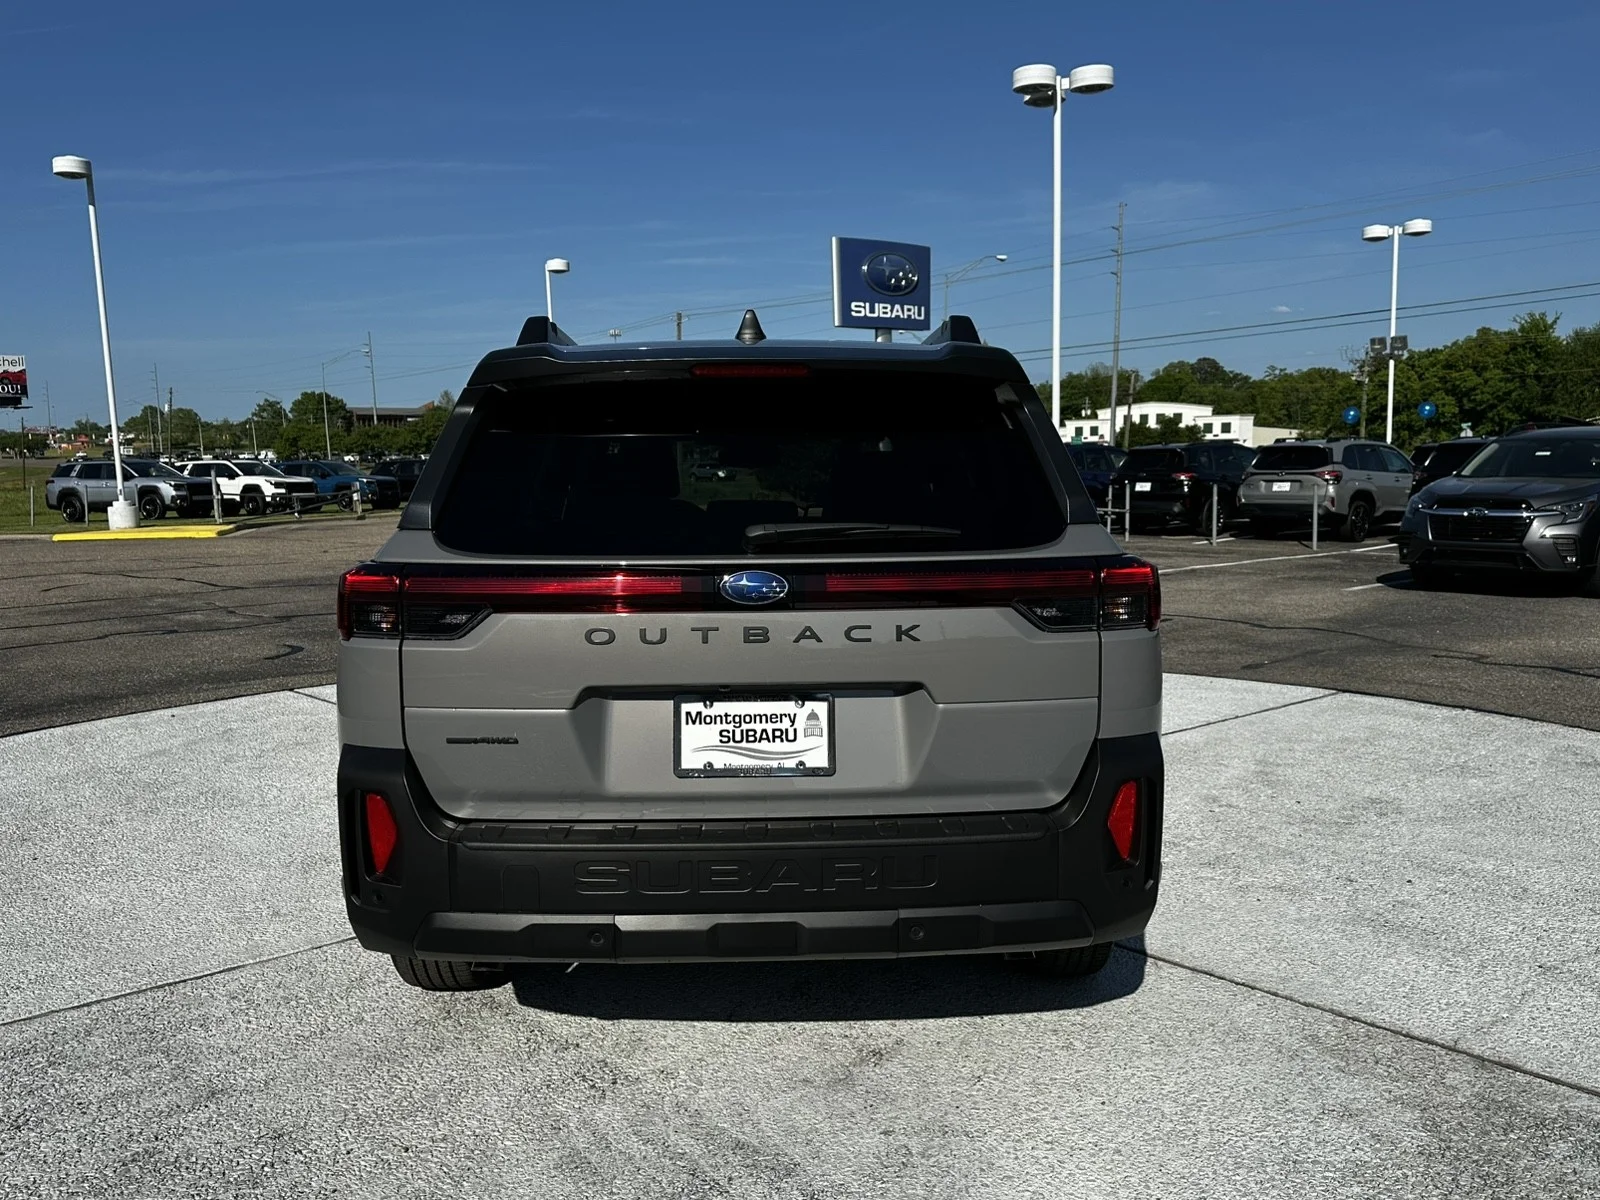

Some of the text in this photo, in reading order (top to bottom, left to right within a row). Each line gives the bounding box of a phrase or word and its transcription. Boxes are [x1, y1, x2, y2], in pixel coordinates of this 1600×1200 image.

[850, 301, 925, 320] SUBARU
[584, 624, 921, 646] OUTBACK
[685, 711, 797, 729] Montgomery
[719, 728, 797, 744] SUBARU
[573, 854, 939, 895] SUBARU
